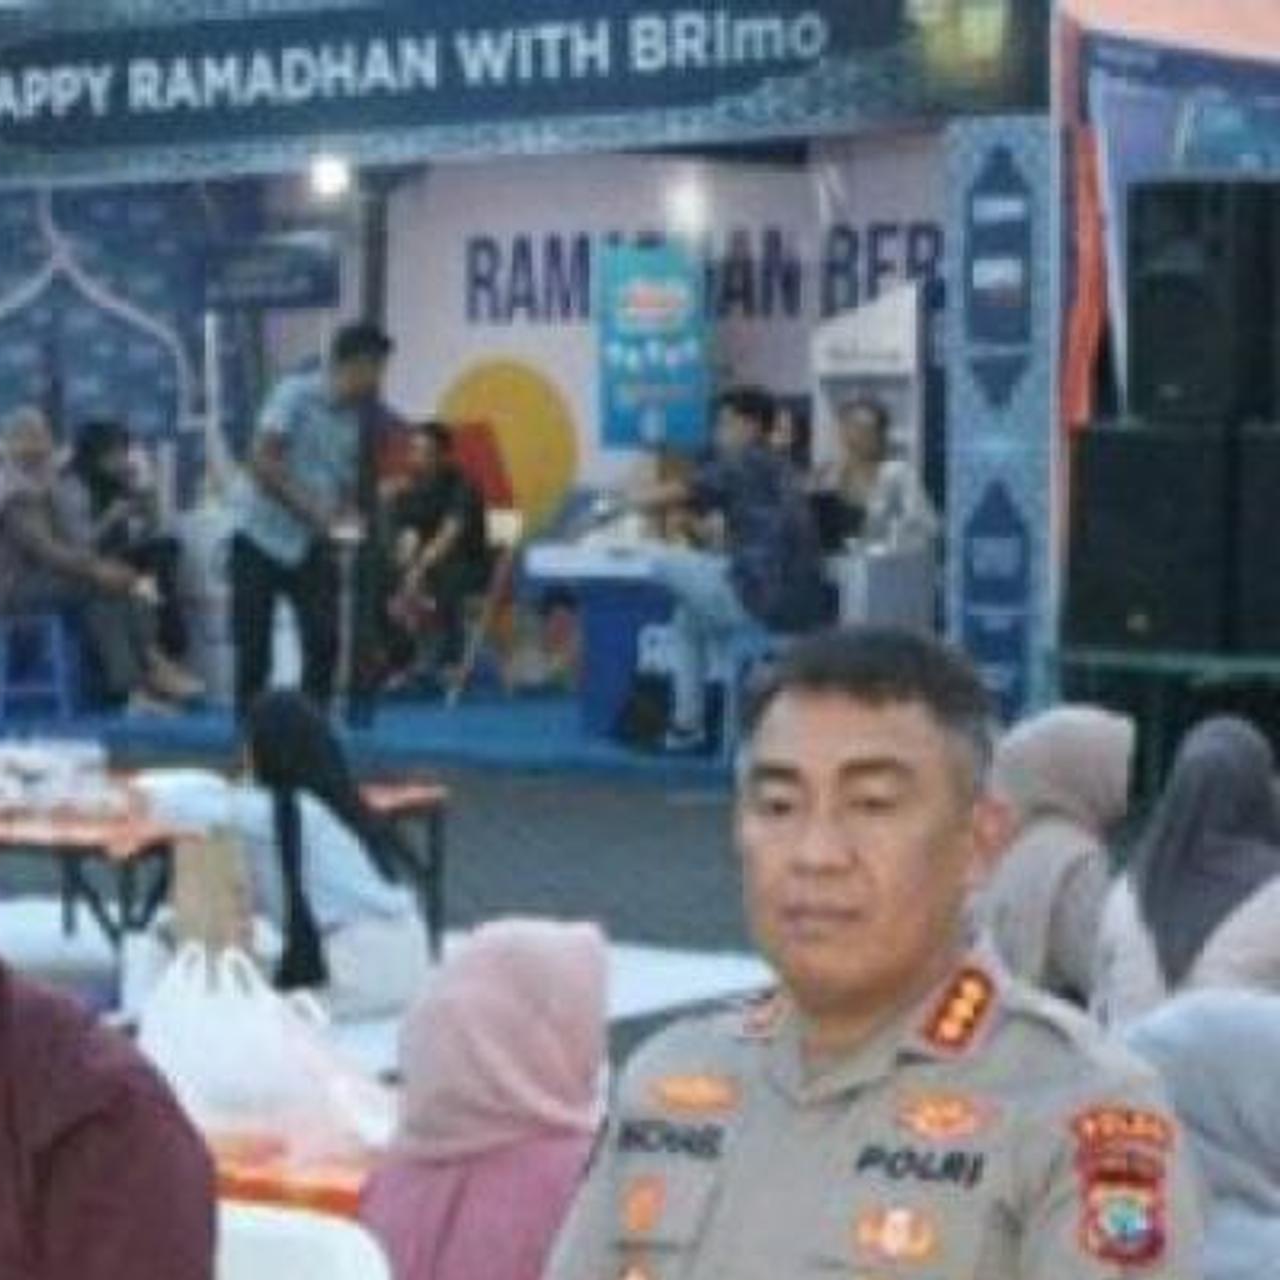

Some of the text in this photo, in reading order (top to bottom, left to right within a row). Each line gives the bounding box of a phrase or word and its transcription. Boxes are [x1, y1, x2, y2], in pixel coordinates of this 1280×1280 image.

[127, 36, 438, 112] RAMADHAN
[454, 19, 610, 87] WITH
[465, 228, 803, 324] RAMAN
[855, 1144, 983, 1188] POLRI
